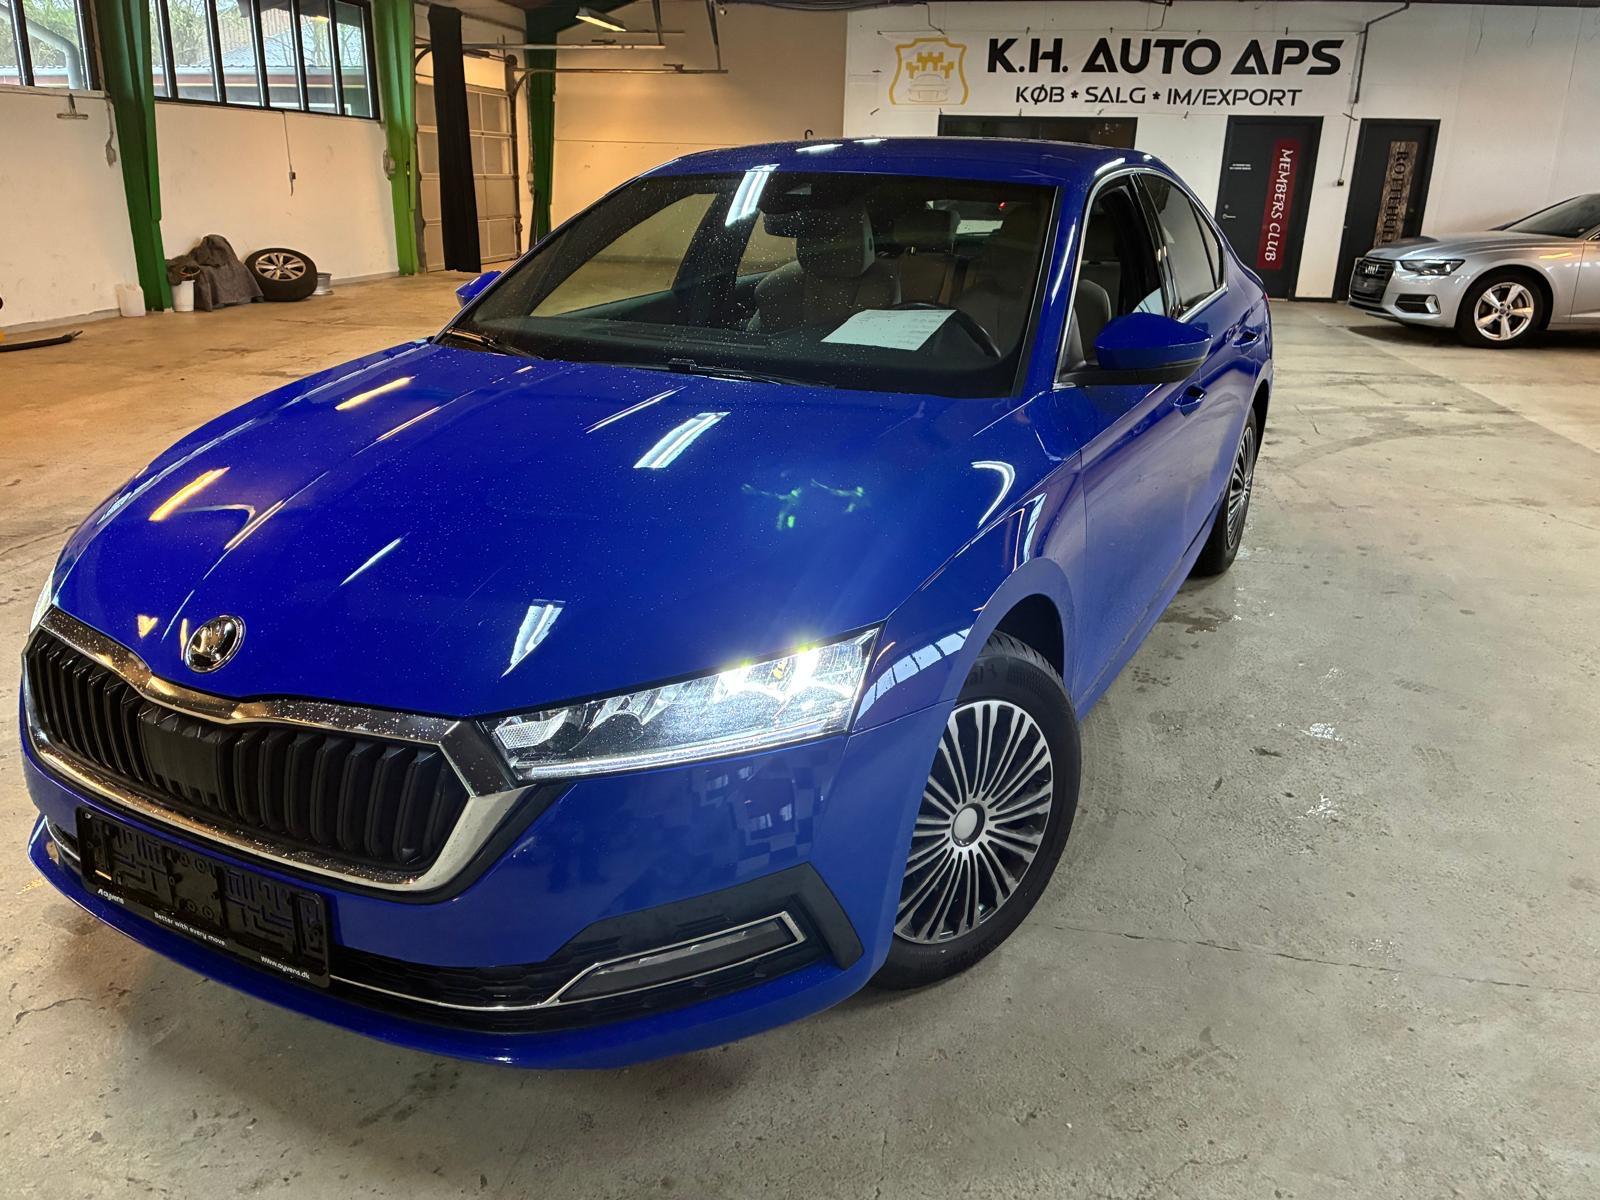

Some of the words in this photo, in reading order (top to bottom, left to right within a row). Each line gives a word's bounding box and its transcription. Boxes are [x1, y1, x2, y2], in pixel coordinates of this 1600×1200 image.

[987, 38, 1069, 73] K.H.
[1081, 38, 1222, 76] AUTO
[1230, 39, 1345, 75] APS
[1016, 84, 1065, 105] KØB
[1084, 86, 1146, 104] SALG
[1166, 88, 1303, 106] IM/EXPORT
[1270, 148, 1294, 220] MEMBERS
[1264, 222, 1281, 262] CLUB
[174, 921, 189, 931] with
[189, 927, 207, 940] every
